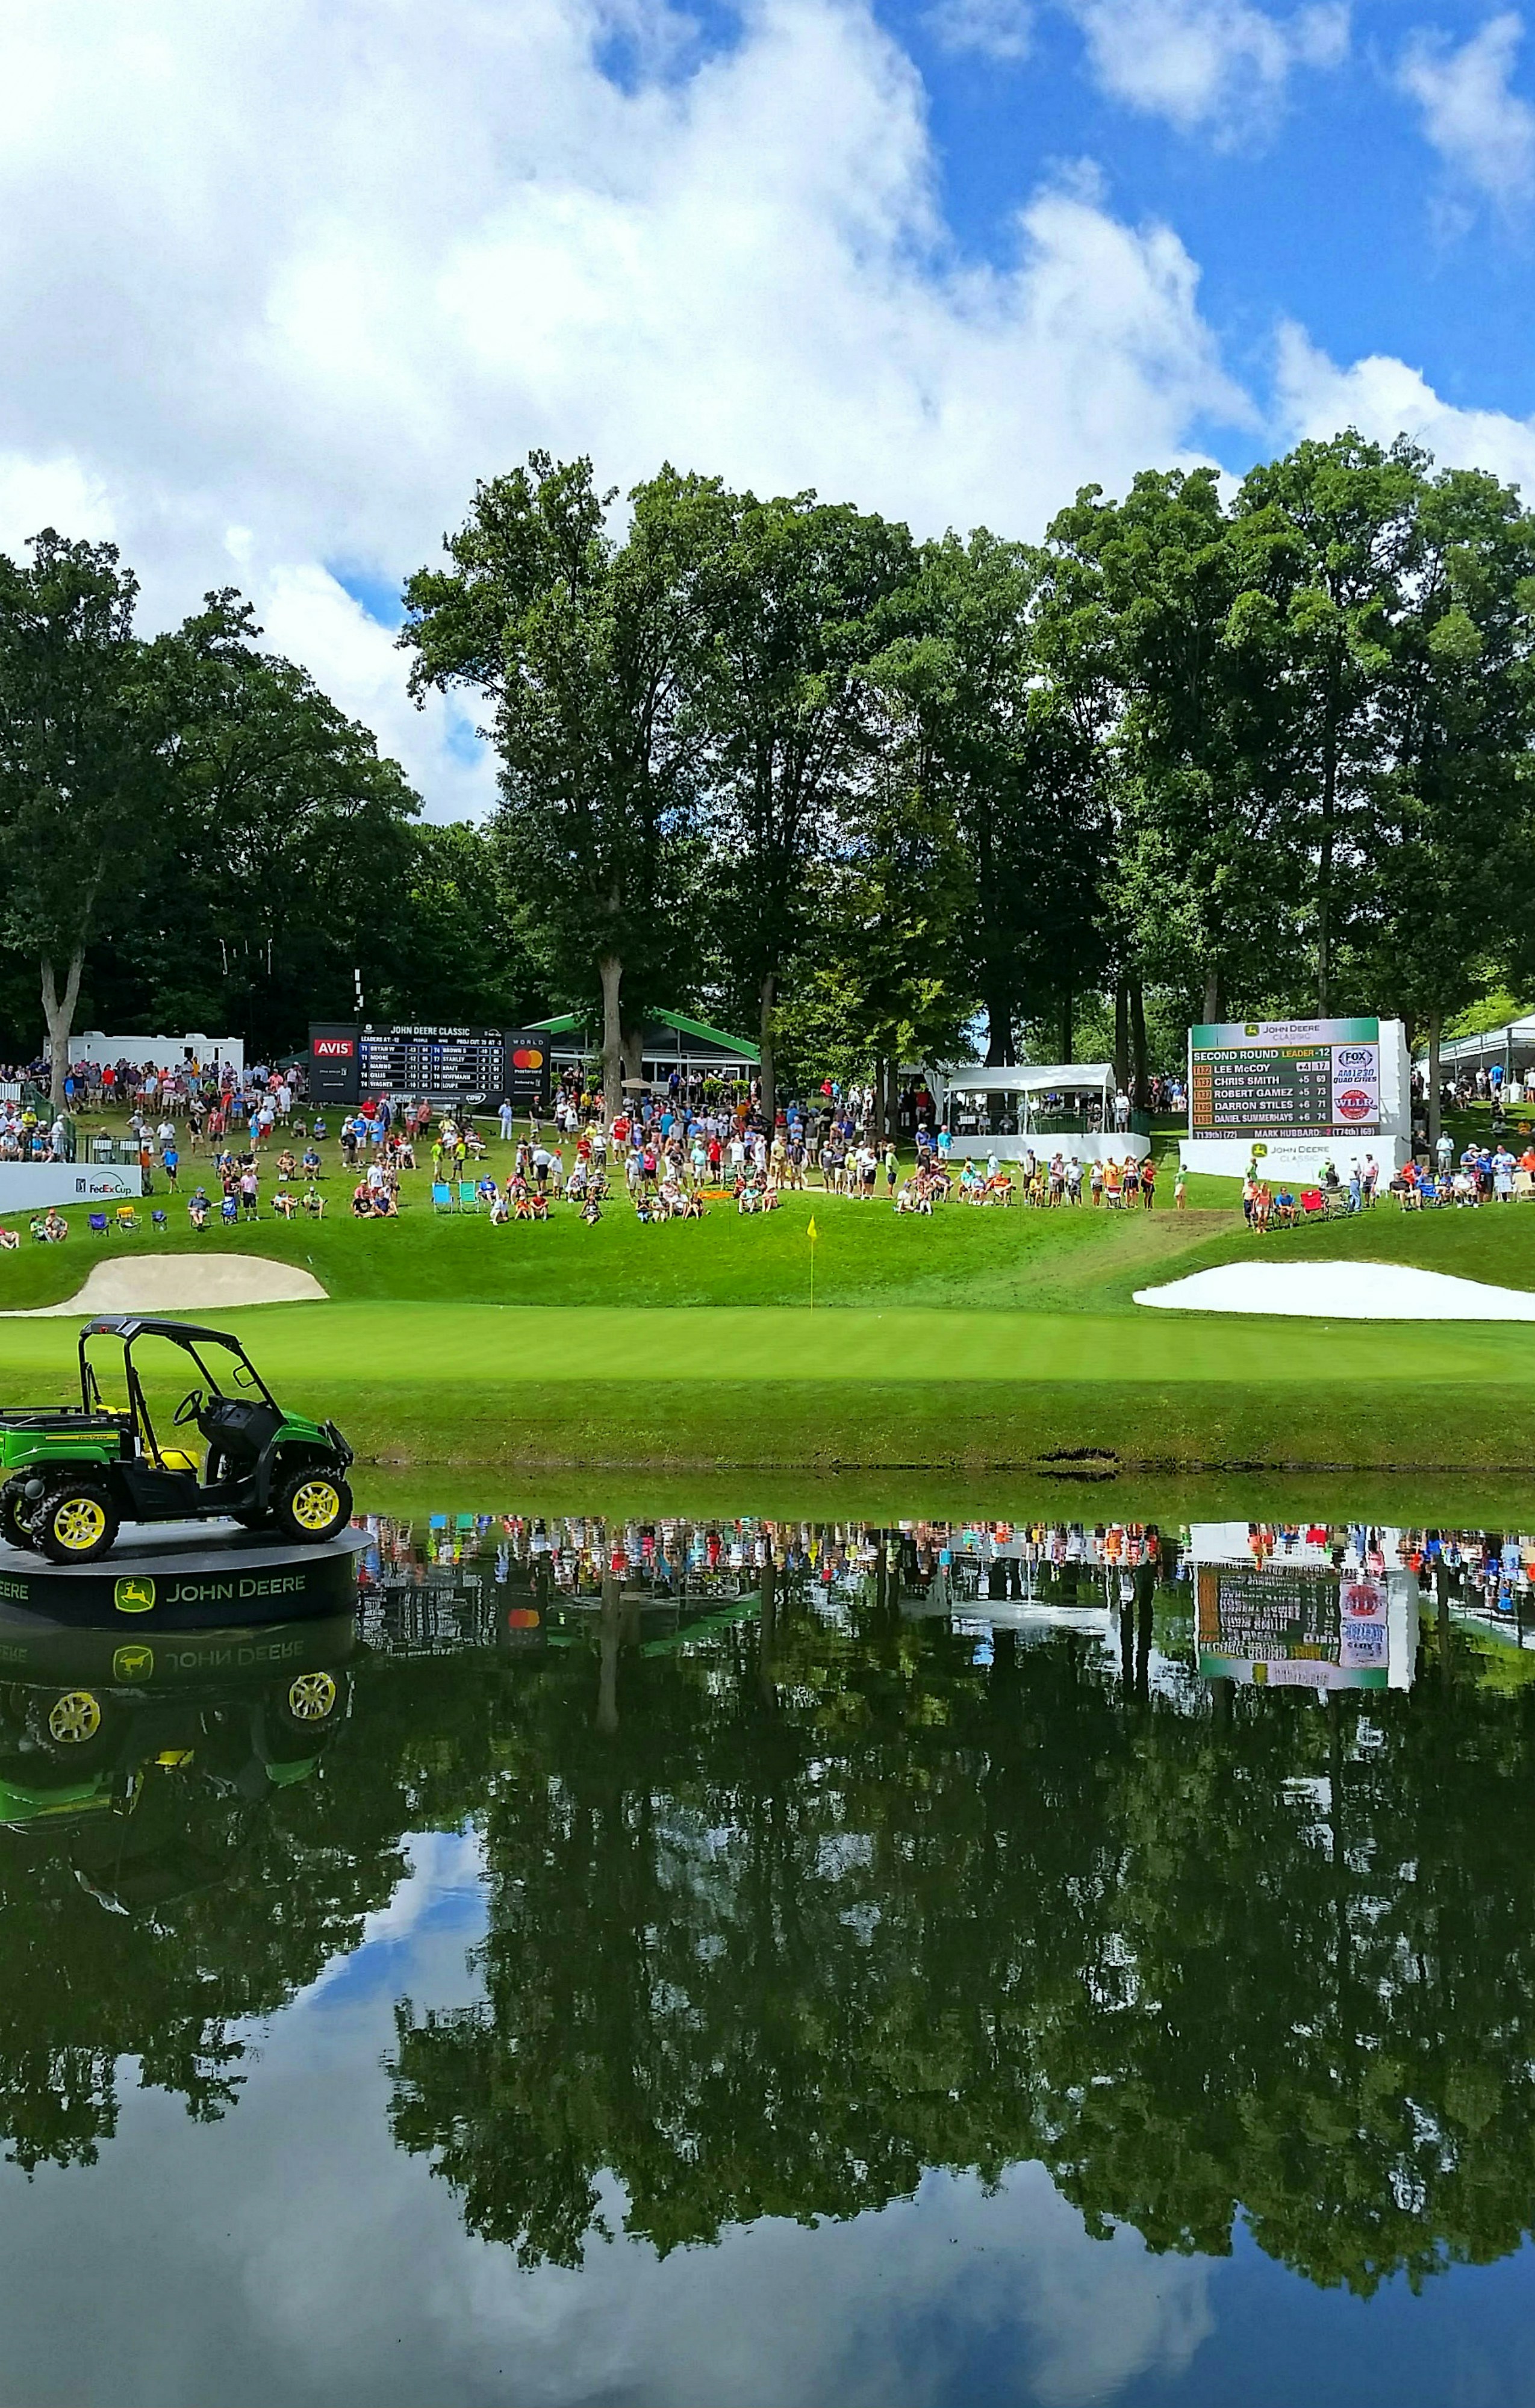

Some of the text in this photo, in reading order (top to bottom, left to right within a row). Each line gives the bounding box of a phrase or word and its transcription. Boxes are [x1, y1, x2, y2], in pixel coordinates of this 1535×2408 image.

[390, 1025, 470, 1036] JOHN DEERE CLASSIC
[318, 1042, 349, 1054] AVIS
[1194, 1048, 1331, 1061] SECOND ROUND LEADER -12
[1345, 1052, 1366, 1062] FOX
[1213, 1065, 1233, 1074] LEE
[1235, 1063, 1271, 1073] McCOY
[1298, 1063, 1309, 1071] +4
[1214, 1077, 1245, 1086] CHRIS
[1247, 1075, 1280, 1085] SMITH
[1298, 1075, 1310, 1083] +5
[1214, 1089, 1254, 1098] ROBERT
[1256, 1087, 1294, 1098] GAMEZ
[1298, 1087, 1310, 1096] +5
[1317, 1087, 1327, 1095] 73
[1215, 1101, 1257, 1110] DARRON
[1259, 1100, 1294, 1110] STILES
[1317, 1100, 1326, 1108] 71
[1334, 1098, 1378, 1109] WLLR
[1214, 1115, 1241, 1123] DANIEL
[1242, 1113, 1294, 1122] SUMMERHAYS
[1254, 1130, 1278, 1138] MARK
[166, 1575, 306, 1602] JOHN DEERE
